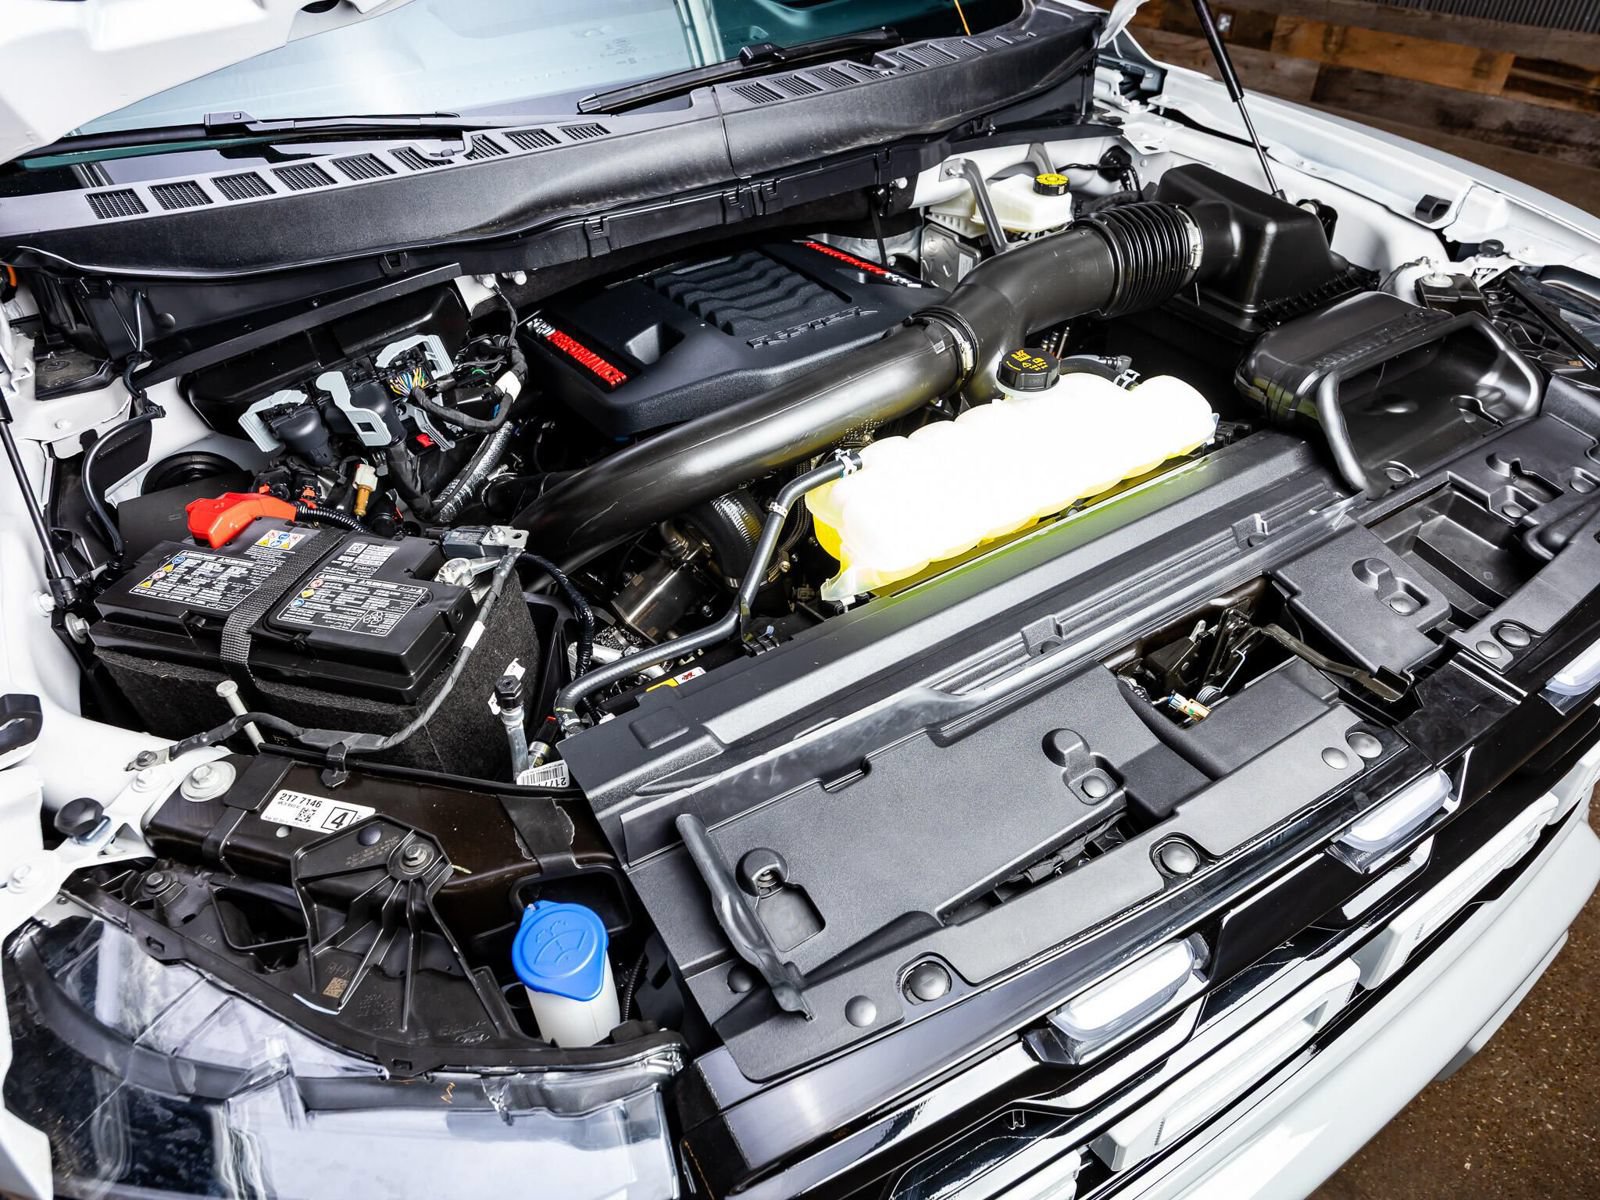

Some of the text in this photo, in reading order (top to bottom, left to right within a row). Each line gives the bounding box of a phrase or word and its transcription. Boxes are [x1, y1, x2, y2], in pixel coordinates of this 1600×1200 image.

[546, 329, 628, 387] PERFORMANCE
[279, 792, 298, 804] 217
[299, 796, 323, 809] 7146
[331, 811, 349, 829] 4
